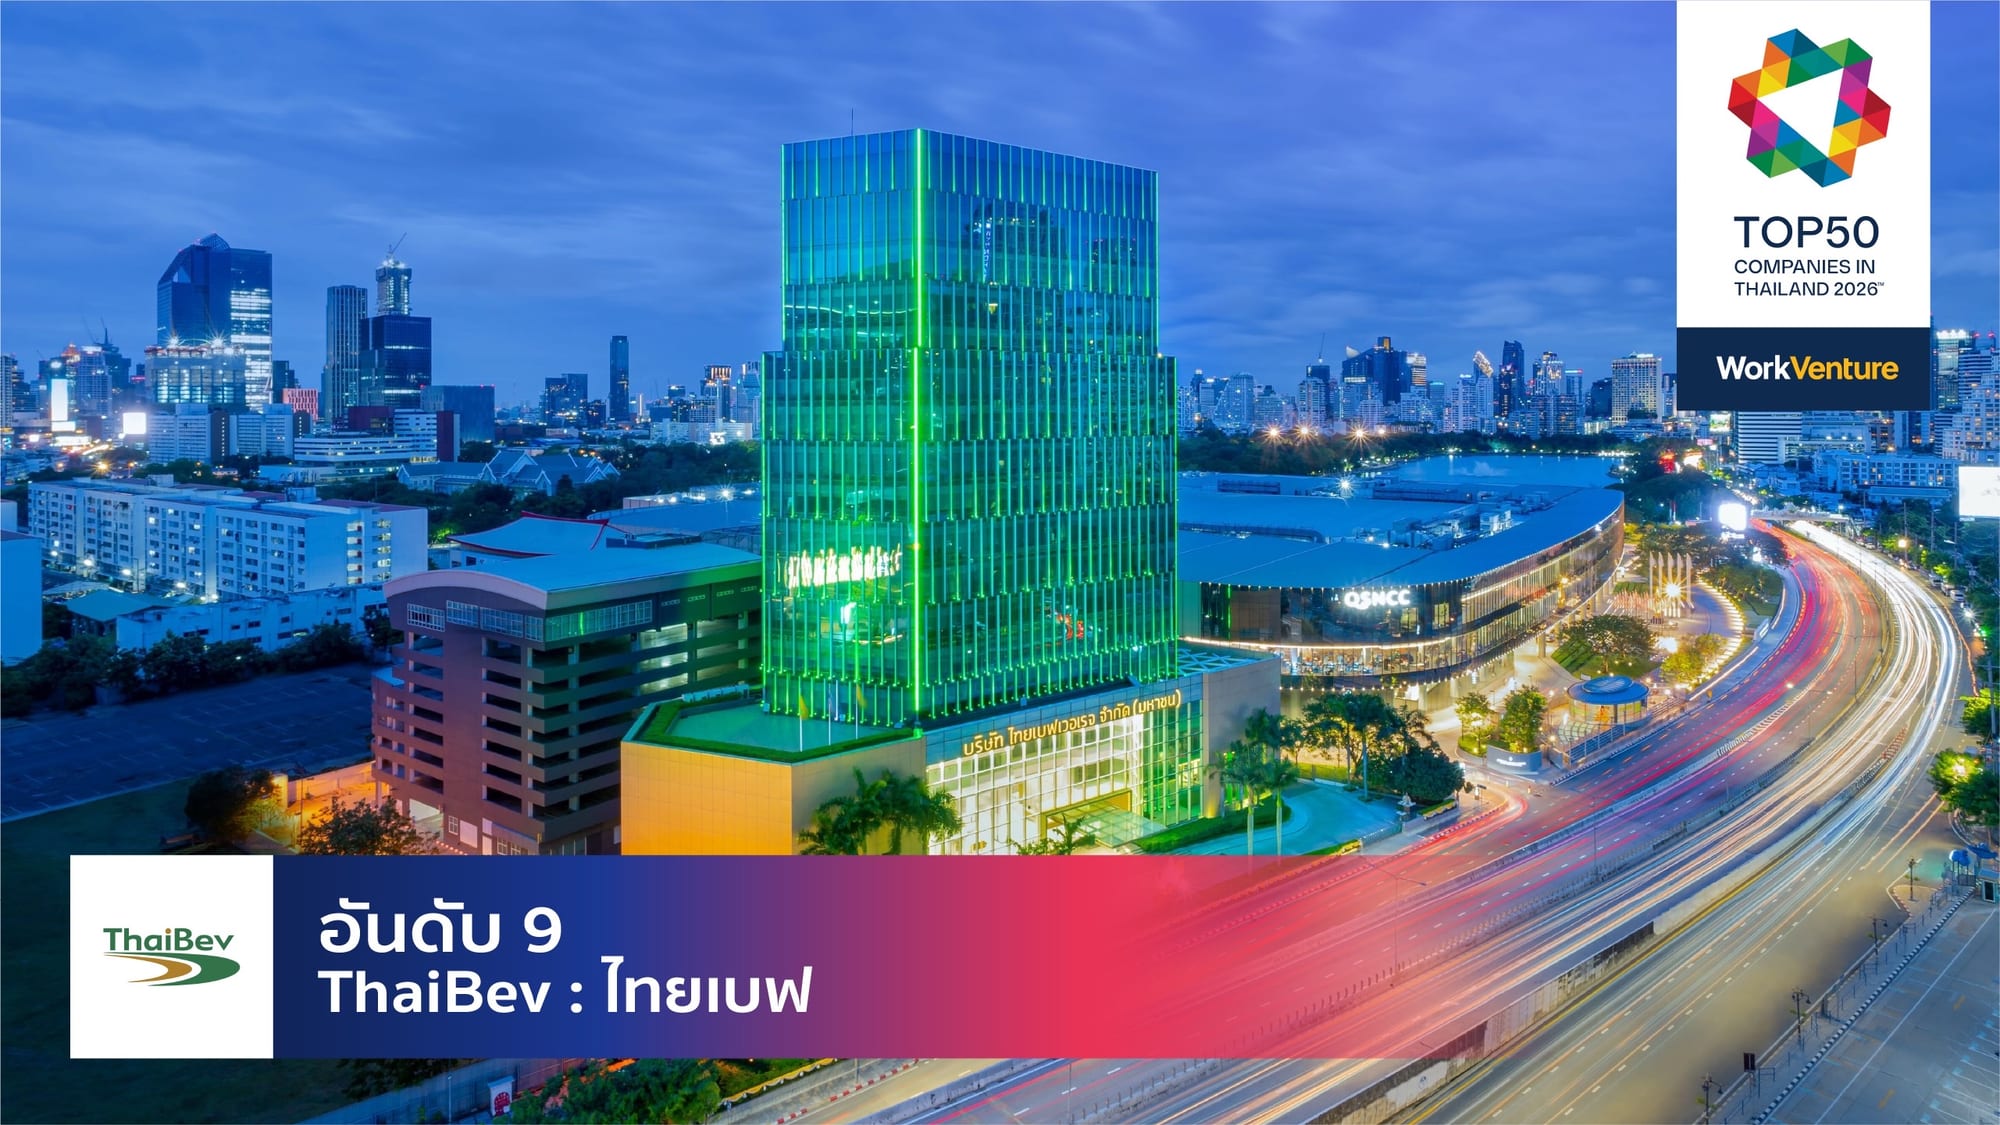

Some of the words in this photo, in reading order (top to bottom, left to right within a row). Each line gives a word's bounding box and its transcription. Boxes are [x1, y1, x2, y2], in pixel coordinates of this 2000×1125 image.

[1344, 589, 1411, 610] QSNCC
[963, 729, 1005, 756] บริษัท
[1008, 713, 1096, 747] ไทยเบฟเวอเรจ
[1099, 702, 1131, 724] จำกัด
[1132, 689, 1182, 716] (มหาชน)
